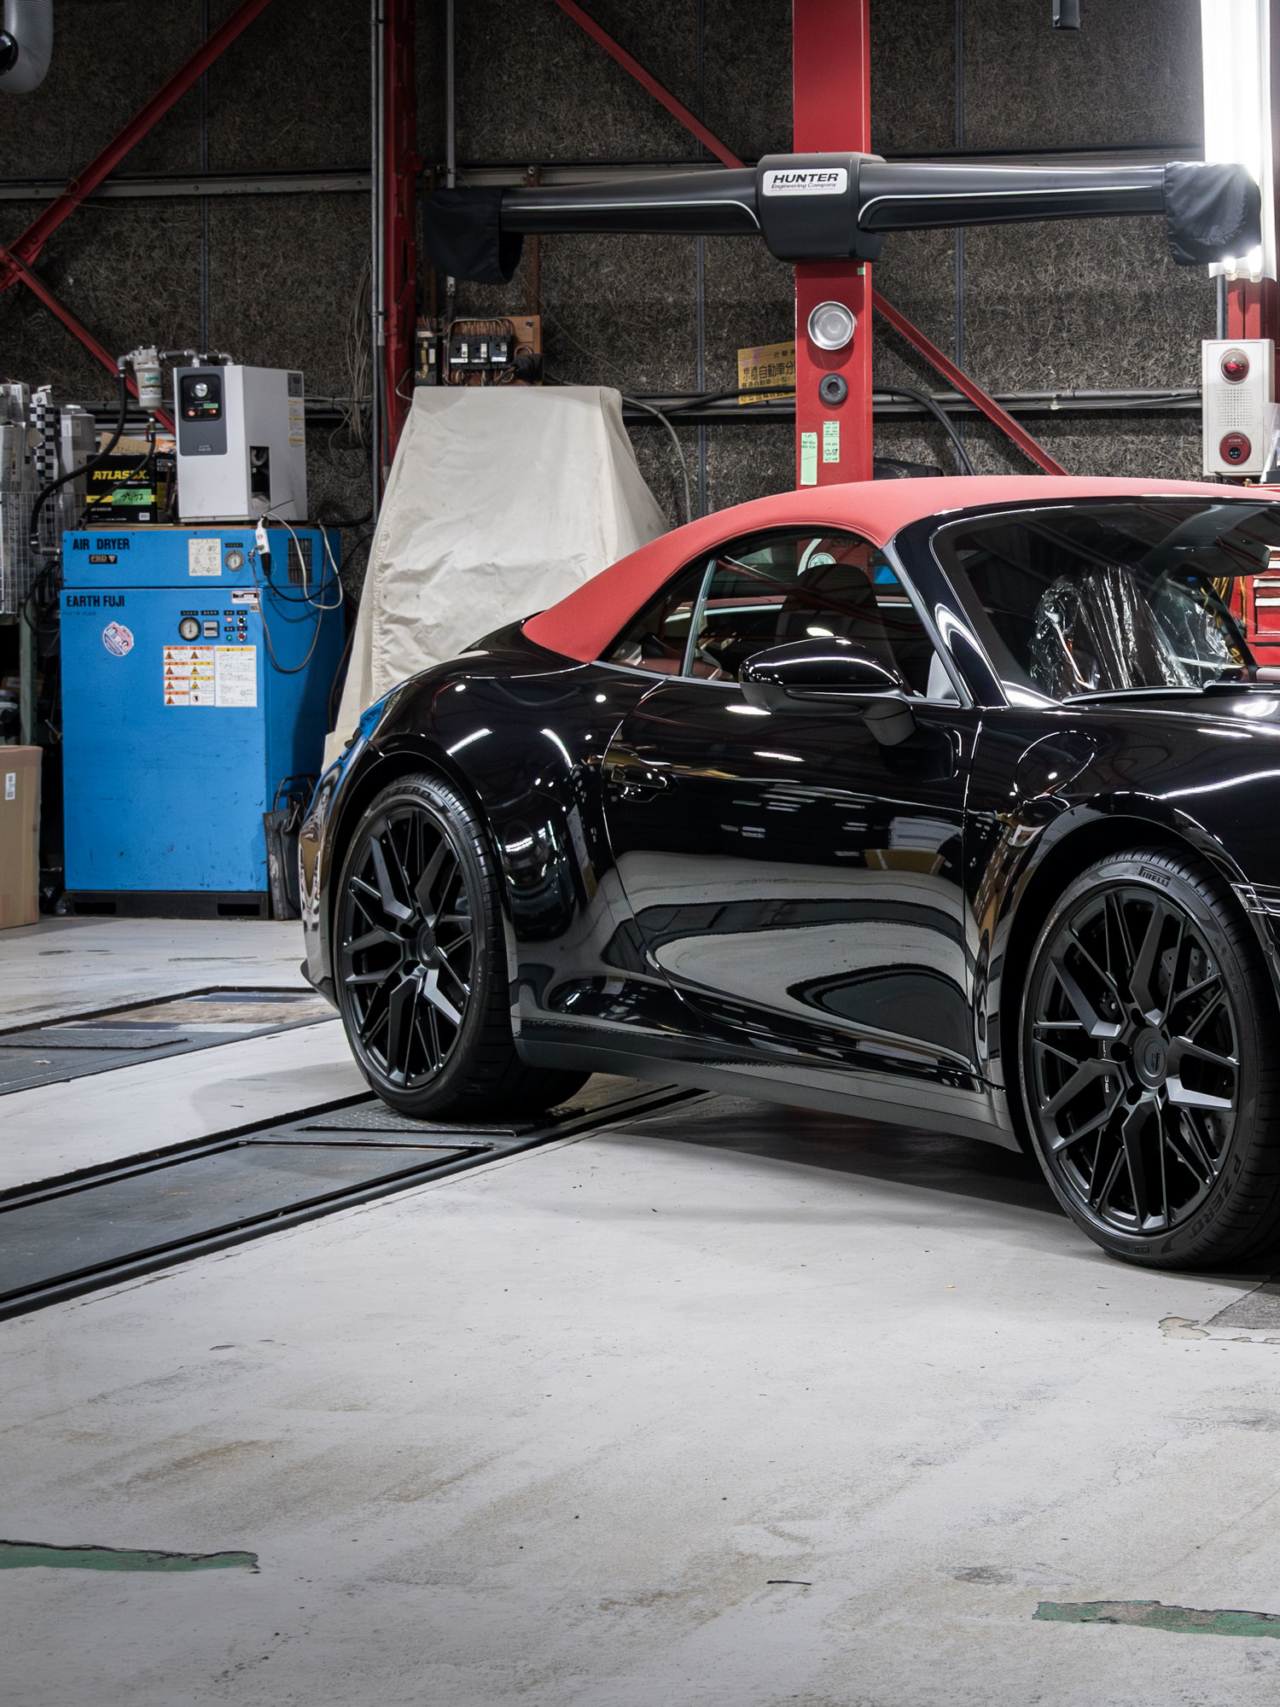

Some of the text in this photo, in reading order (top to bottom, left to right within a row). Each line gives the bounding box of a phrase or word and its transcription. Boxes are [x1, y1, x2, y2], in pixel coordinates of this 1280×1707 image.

[772, 173, 839, 184] HUNTER
[72, 538, 130, 550] AIR DRYER
[66, 595, 125, 607] EARTH FUJI
[1138, 866, 1172, 888] PIRELLI
[1190, 1153, 1242, 1237] P ZERO
